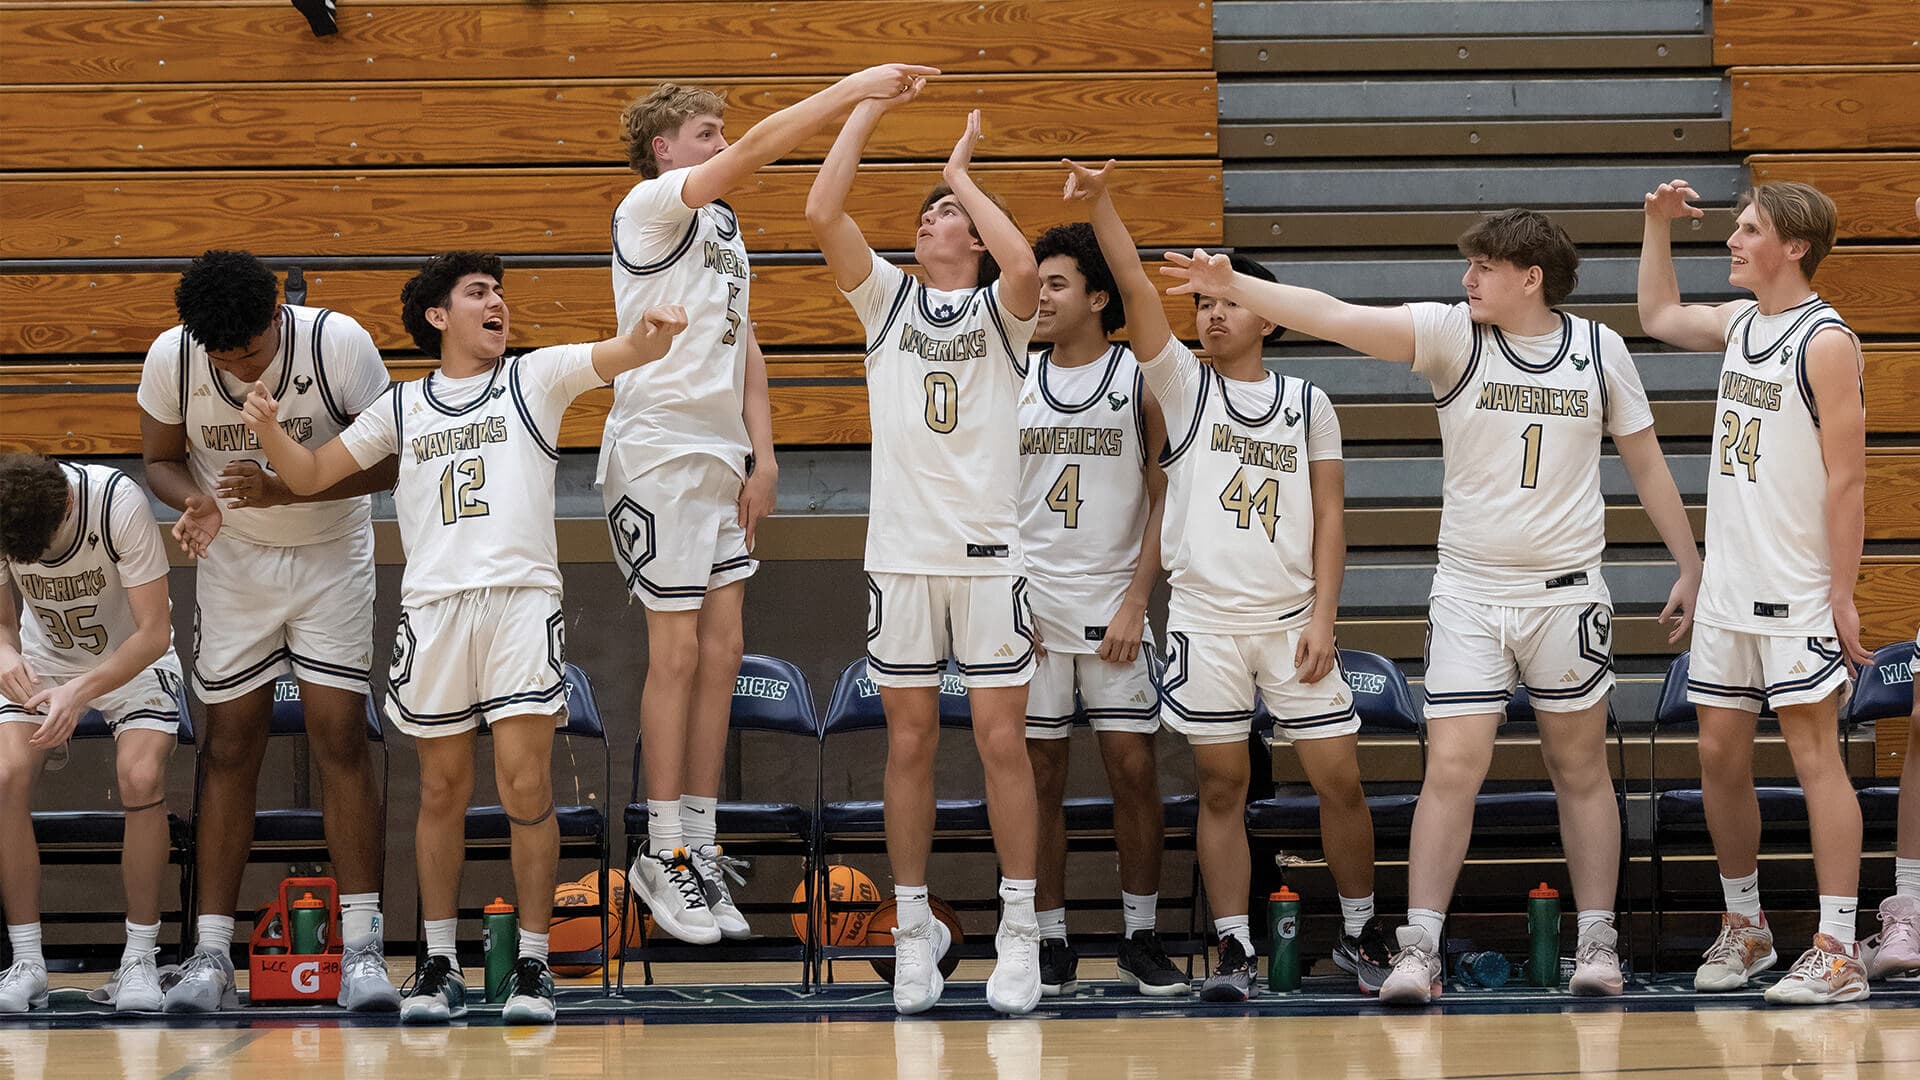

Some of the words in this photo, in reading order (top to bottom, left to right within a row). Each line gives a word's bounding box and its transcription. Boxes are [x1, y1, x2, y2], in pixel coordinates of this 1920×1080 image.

[899, 323, 986, 361] MAVERICKS
[924, 371, 958, 434] 0
[1476, 382, 1588, 418] MAVERICKS
[1019, 427, 1123, 456] MAVERICKS
[1520, 423, 1543, 489] 1
[1720, 410, 1762, 483] 24
[440, 455, 490, 525] 12
[1045, 464, 1084, 529] 4
[1219, 465, 1281, 543] 44
[34, 604, 109, 655] 35
